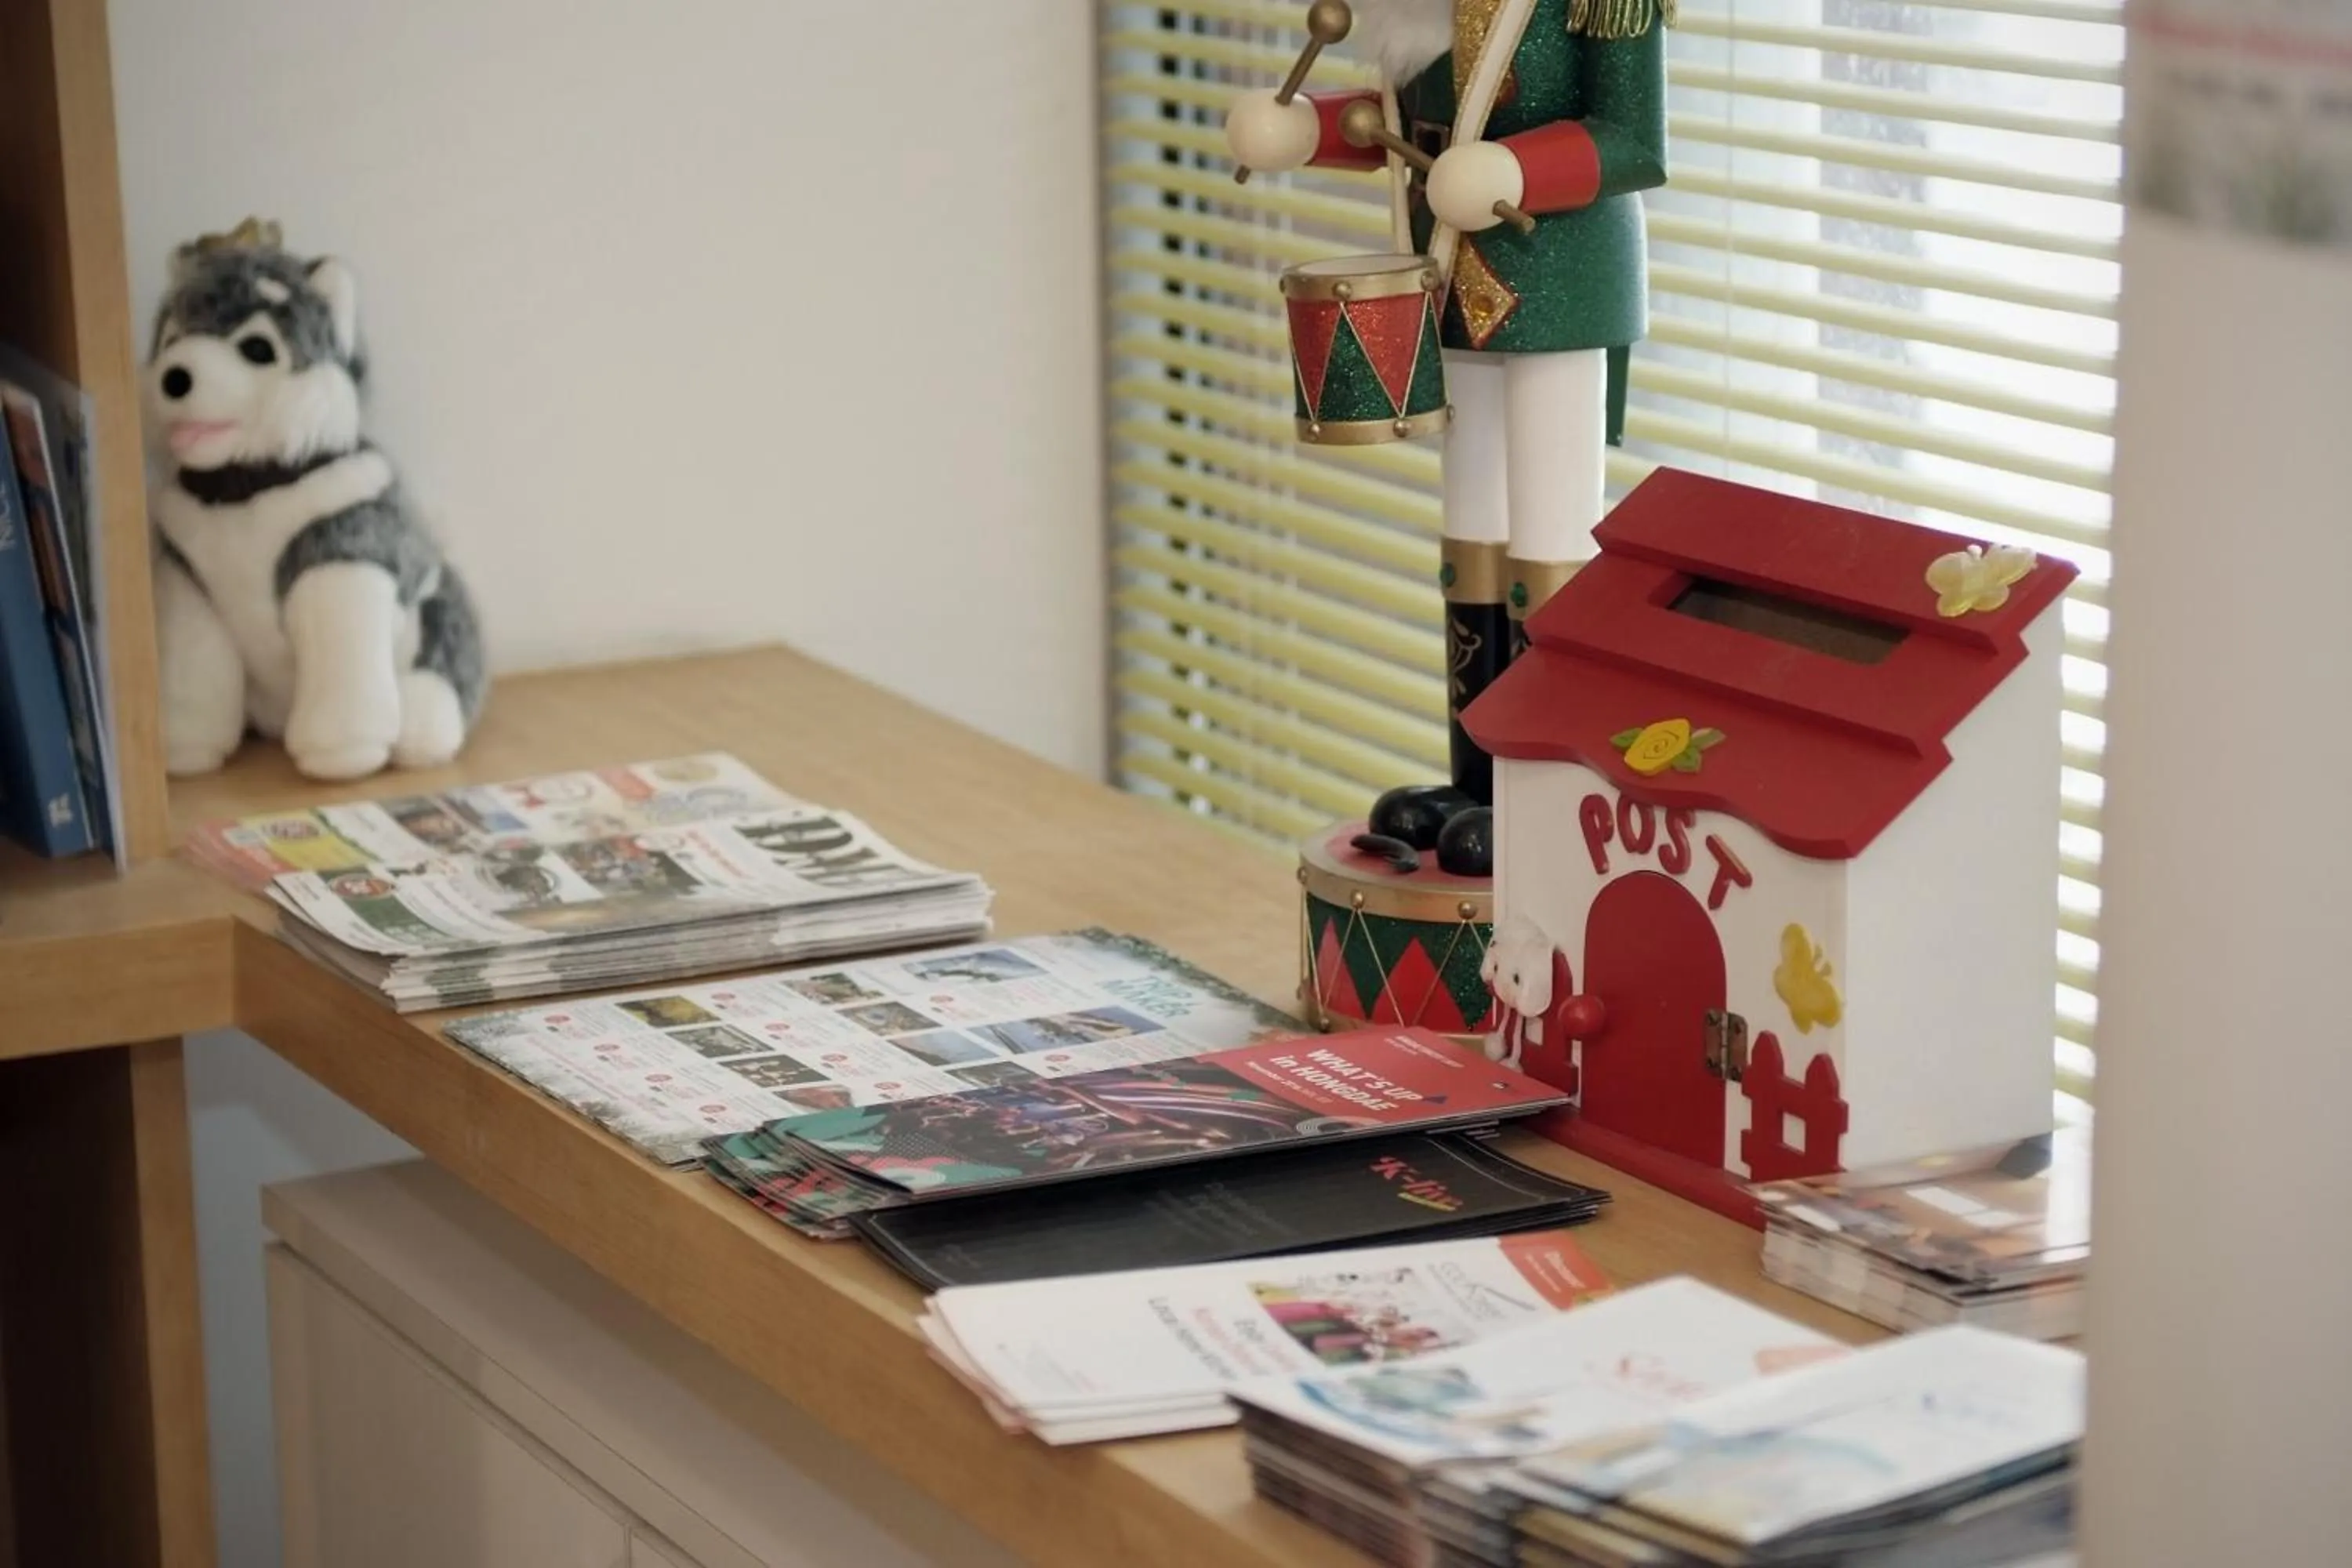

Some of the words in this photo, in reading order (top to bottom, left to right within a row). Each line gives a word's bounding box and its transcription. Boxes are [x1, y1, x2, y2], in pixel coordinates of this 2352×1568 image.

[1579, 790, 1753, 910] POST
[1269, 1054, 1299, 1069] in
[1290, 1065, 1400, 1111] HONGDAE
[1306, 1048, 1395, 1089] WHAT'S
[1382, 1087, 1424, 1101] UP
